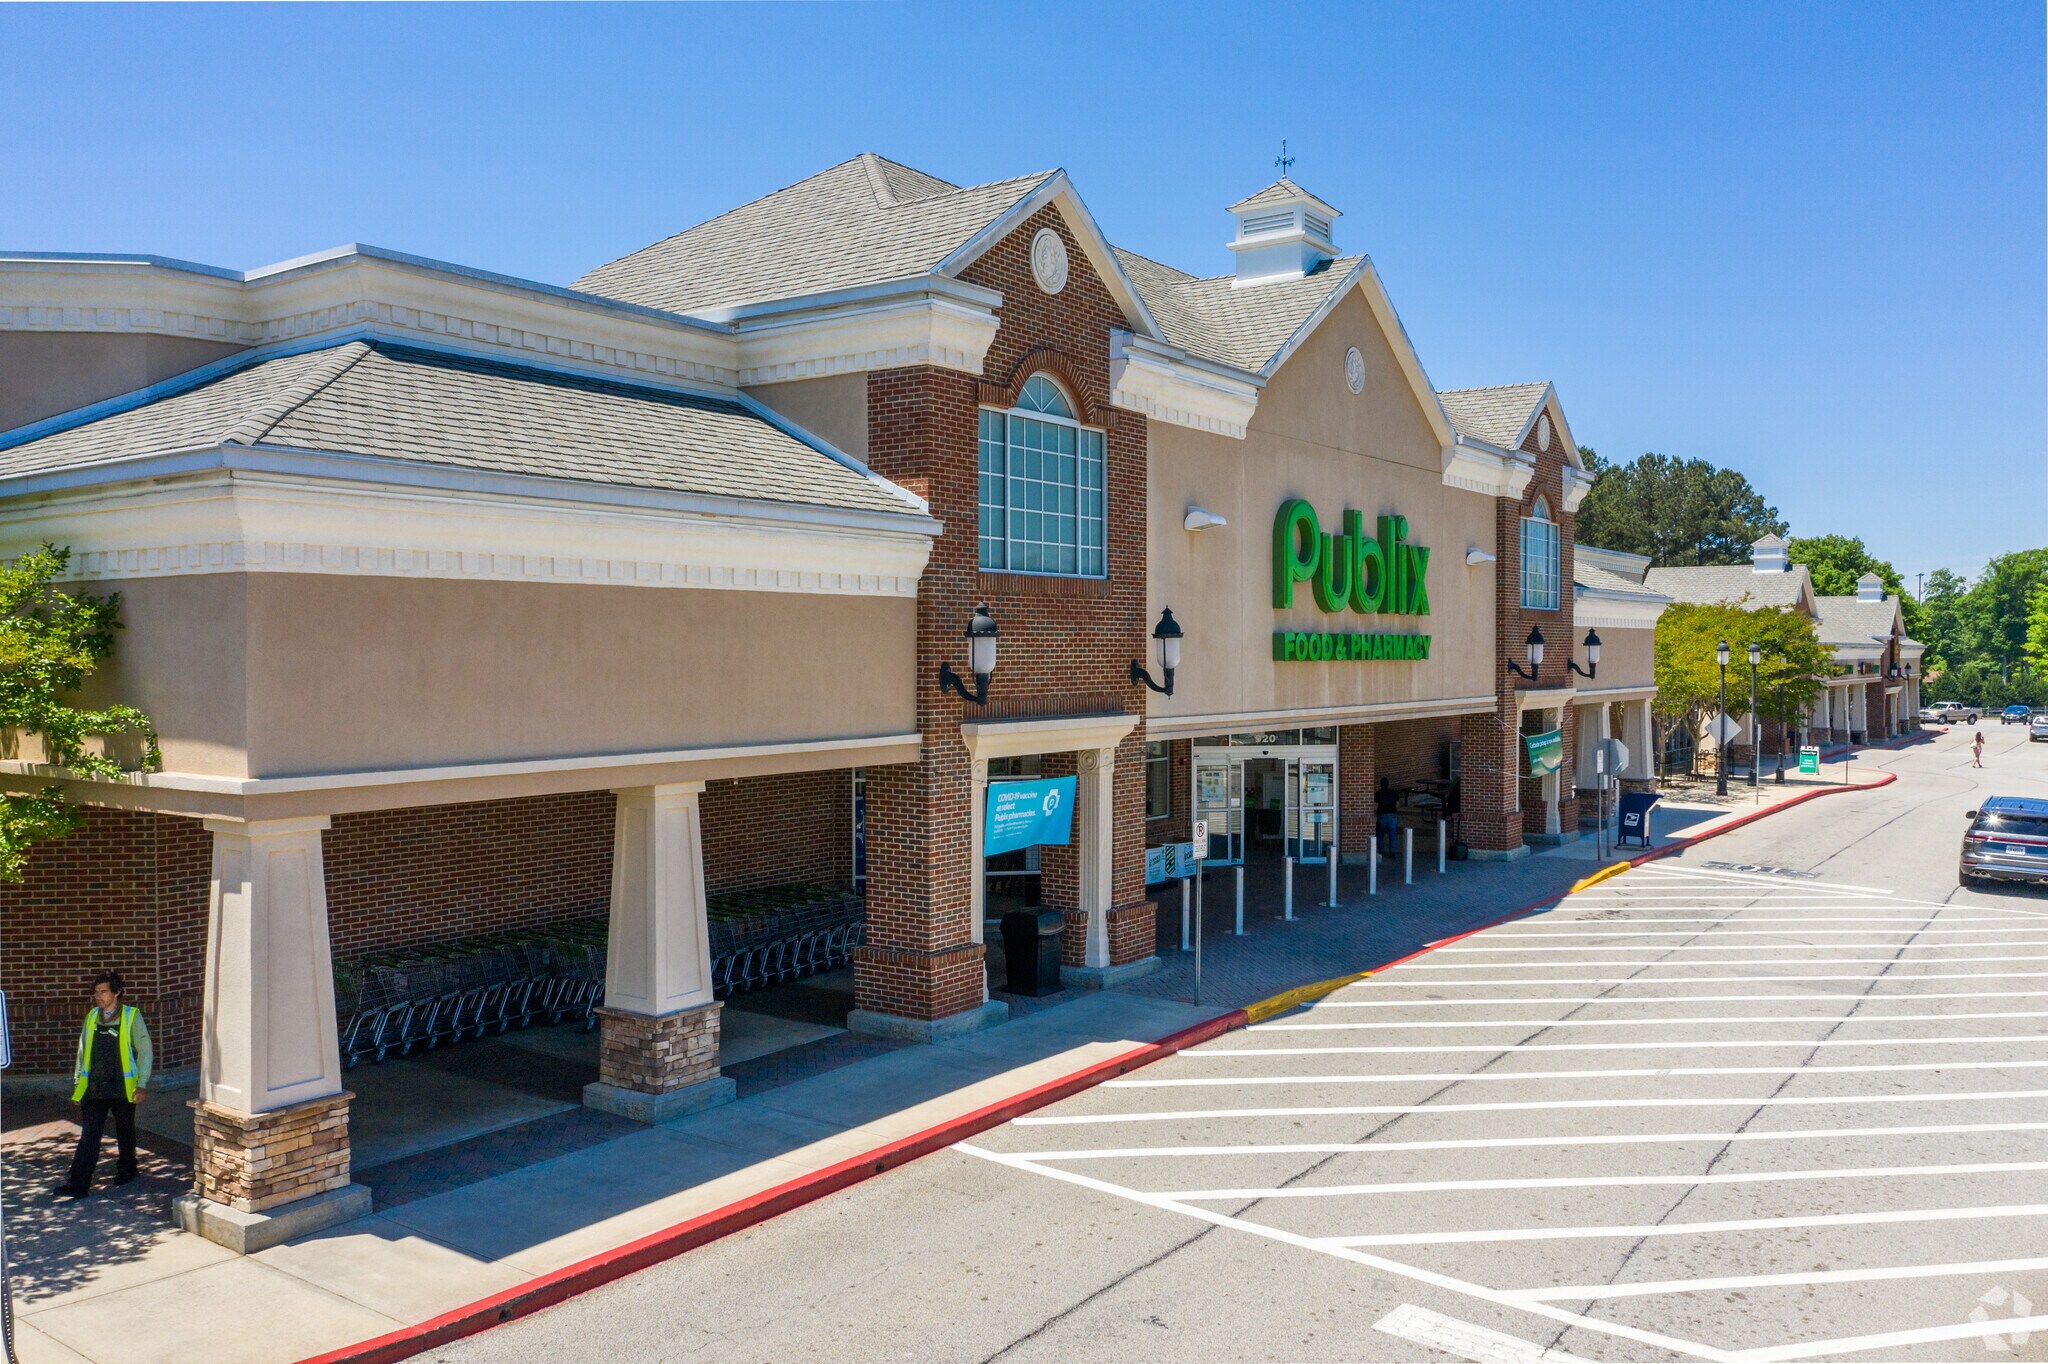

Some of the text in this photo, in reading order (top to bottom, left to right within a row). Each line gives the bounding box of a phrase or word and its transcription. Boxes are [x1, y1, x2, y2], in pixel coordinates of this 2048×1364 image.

[1273, 498, 1431, 616] Publix
[1279, 632, 1432, 661] FOOD & PHARMACY
[1255, 734, 1276, 744] 920
[998, 792, 1020, 802] COVID-19
